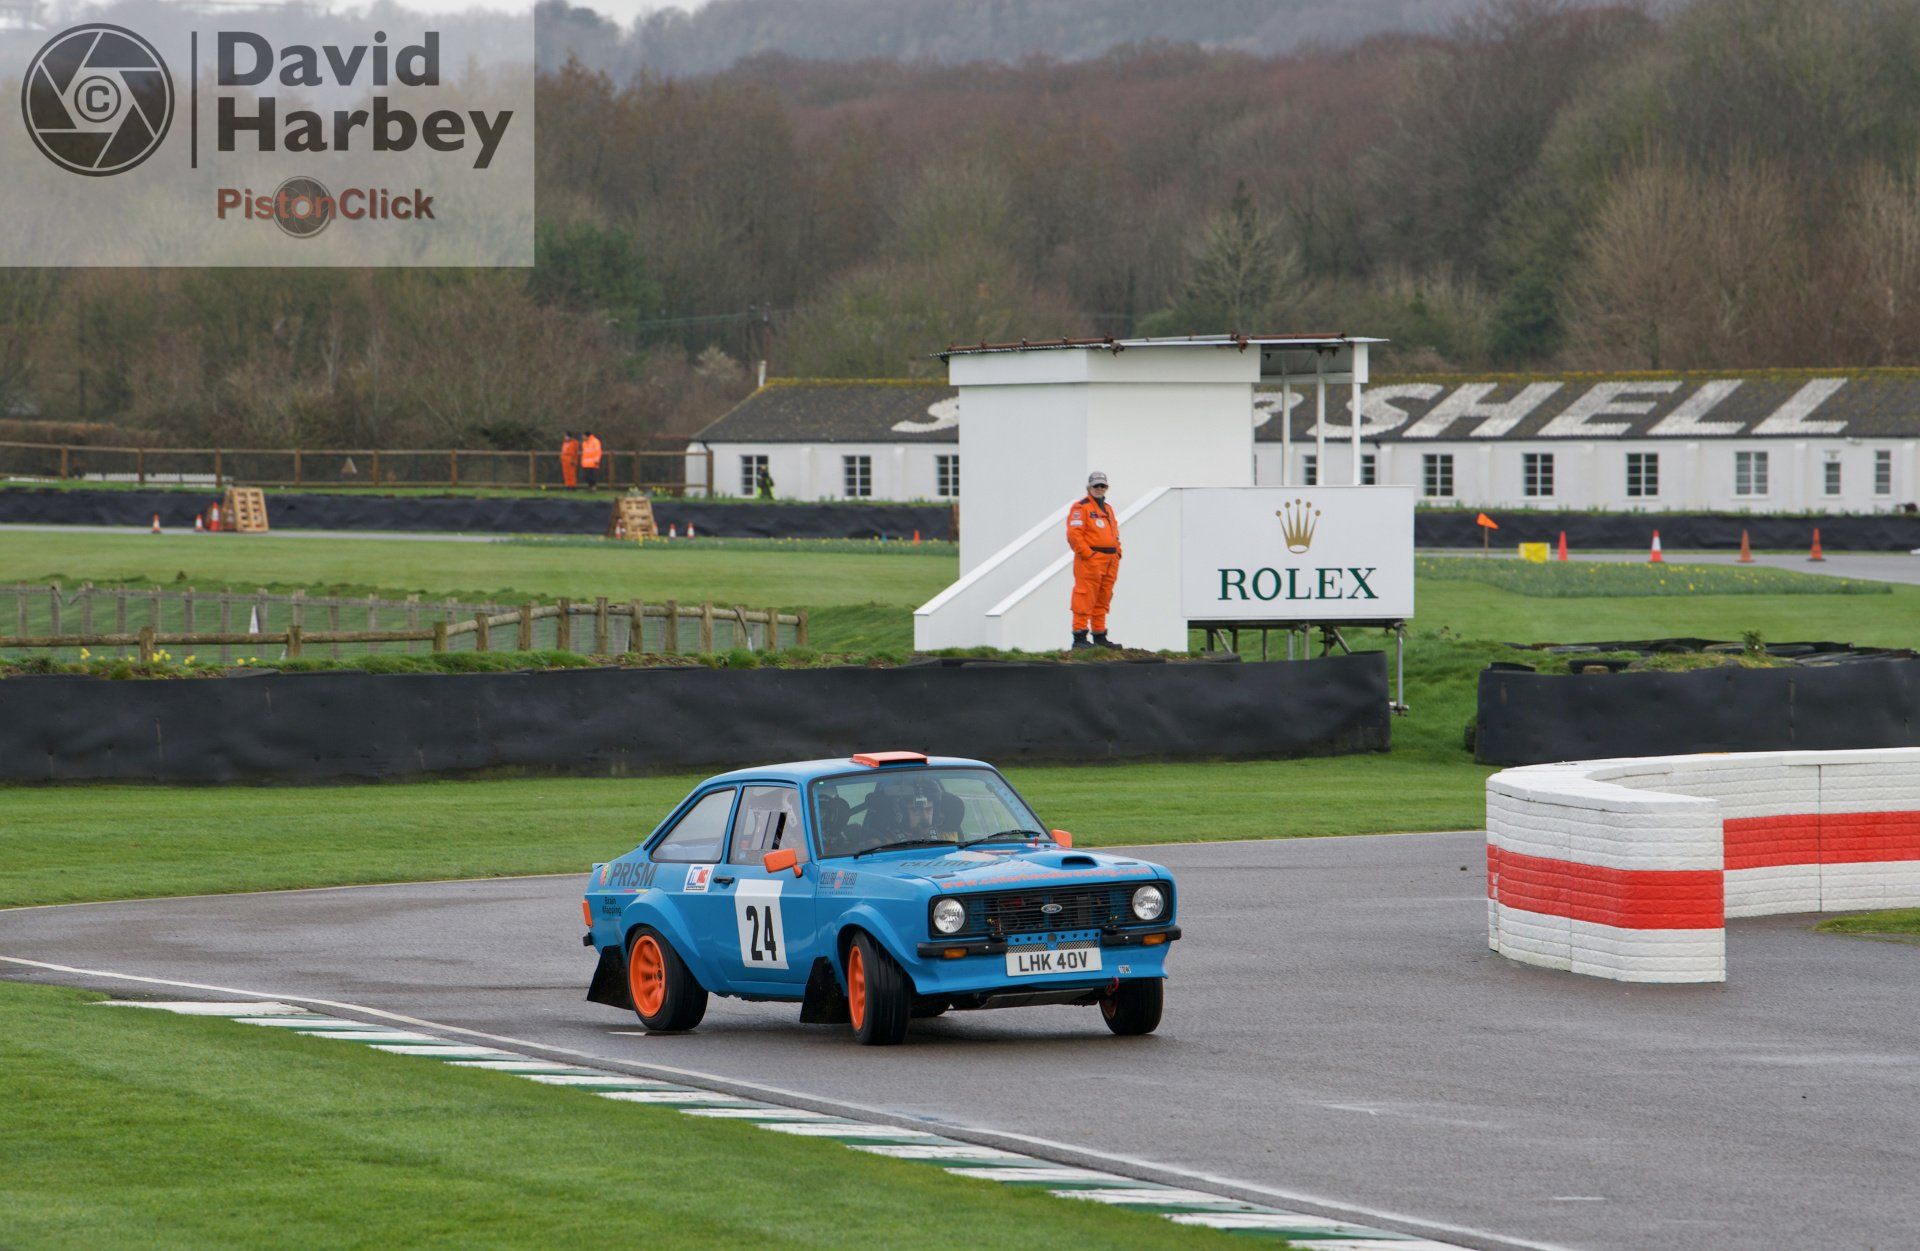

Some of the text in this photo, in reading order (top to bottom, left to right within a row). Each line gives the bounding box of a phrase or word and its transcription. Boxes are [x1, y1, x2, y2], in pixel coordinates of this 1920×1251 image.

[1306, 378, 1848, 438] SHELL
[1218, 567, 1379, 600] ROLEX
[609, 862, 659, 886] PRISM
[746, 905, 777, 961] 24
[1018, 951, 1088, 972] LHK 40V
